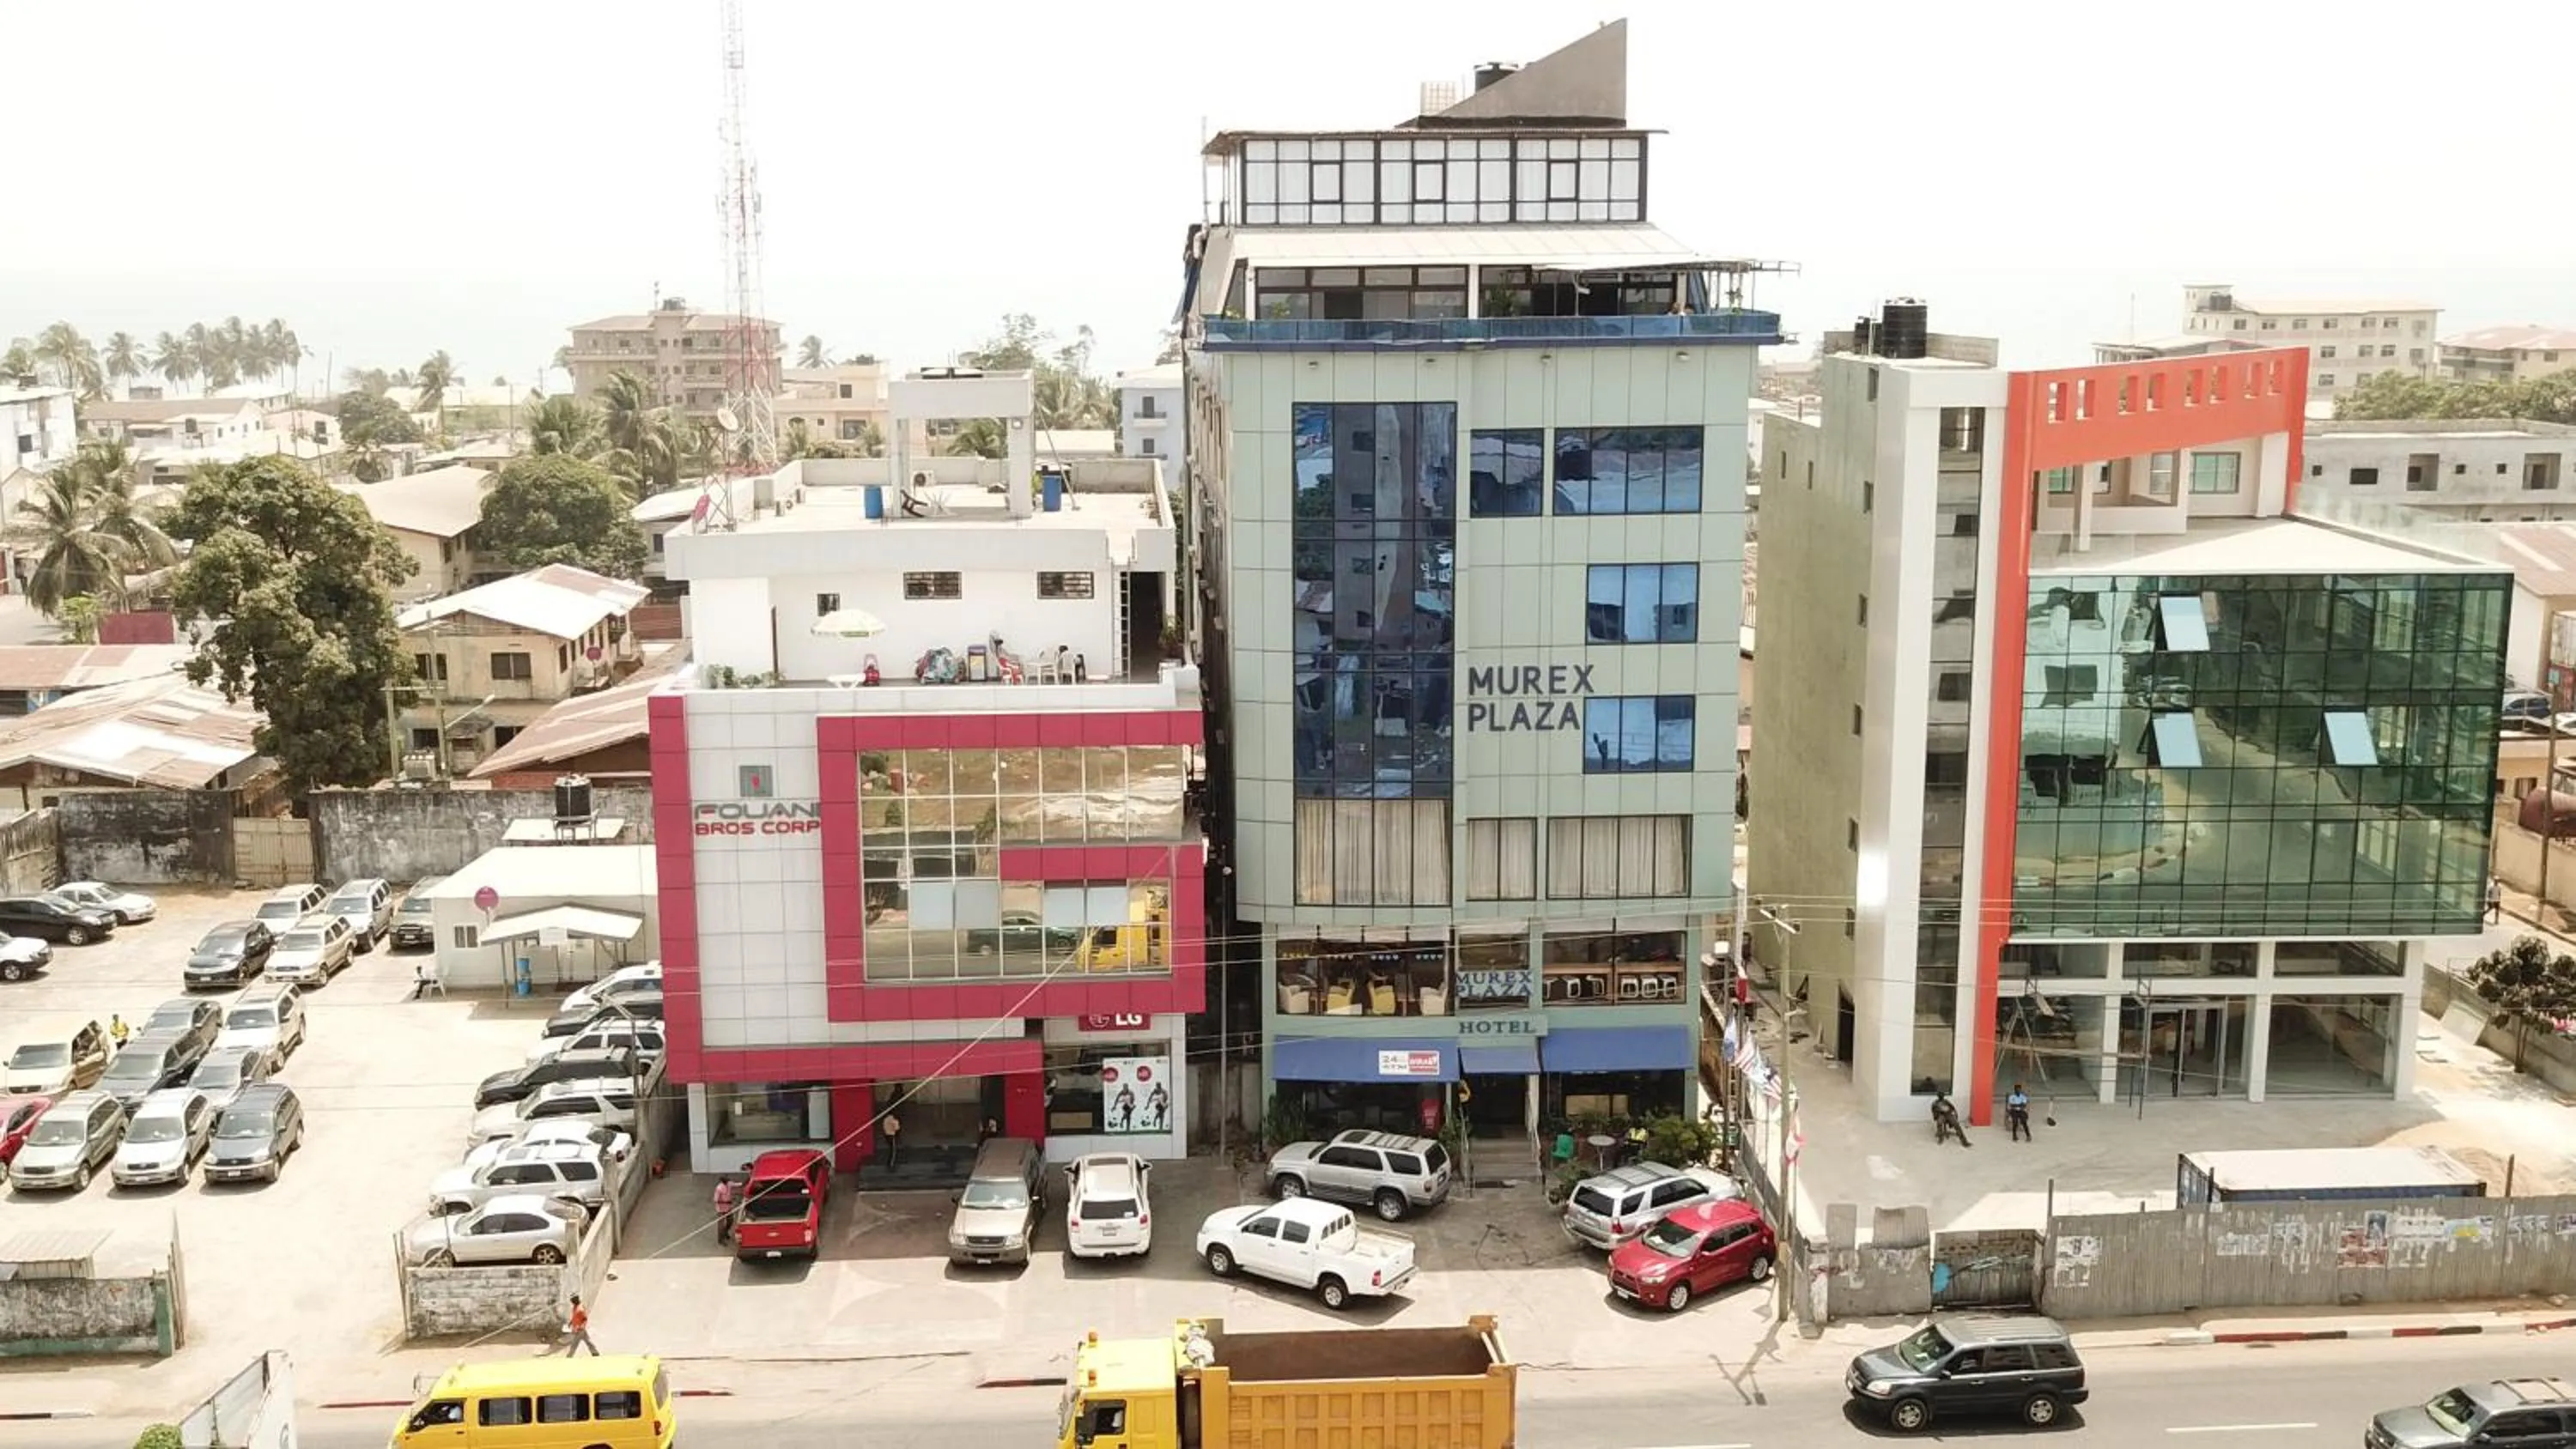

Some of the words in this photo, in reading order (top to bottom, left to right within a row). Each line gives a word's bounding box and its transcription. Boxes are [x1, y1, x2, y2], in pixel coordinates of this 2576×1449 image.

[1468, 664, 1595, 695] MUREX
[1468, 701, 1580, 731] PLAZA
[695, 822, 755, 835] BROS
[761, 820, 820, 834] CORP
[1455, 971, 1532, 985] MUREX
[1456, 984, 1533, 997] PLAZA
[1115, 1013, 1143, 1026] LG
[1459, 1021, 1536, 1034] HOTEL
